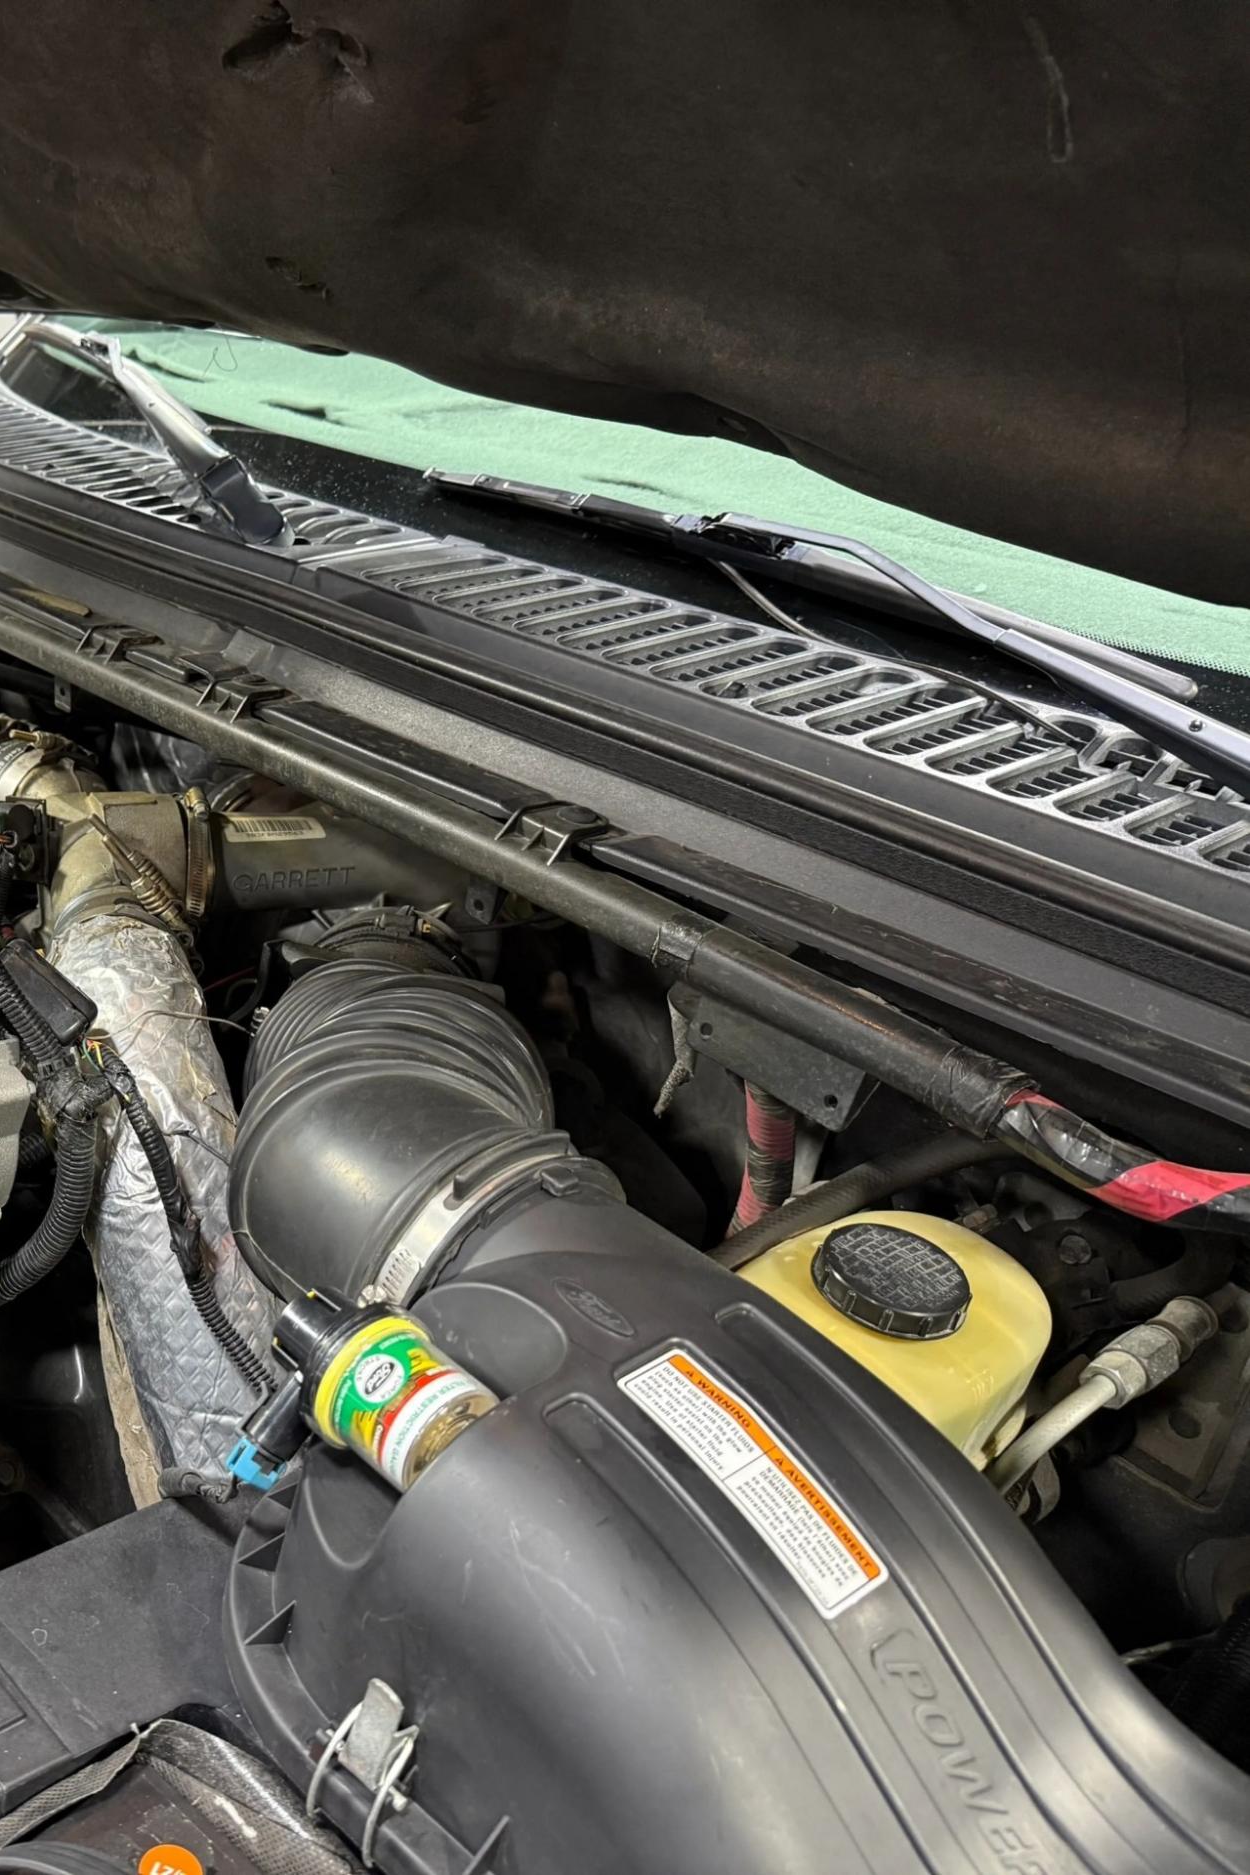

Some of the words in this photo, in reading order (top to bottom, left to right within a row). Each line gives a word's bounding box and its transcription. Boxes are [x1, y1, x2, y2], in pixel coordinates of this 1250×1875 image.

[232, 866, 356, 893] GARRETT
[365, 1362, 394, 1394] Ford
[696, 1377, 753, 1428] WARNING
[662, 1366, 675, 1376] DO
[672, 1374, 689, 1389] NOT
[686, 1387, 702, 1400] USE
[700, 1399, 732, 1427] STARTER
[729, 1425, 754, 1453] FLUIDS
[785, 1467, 873, 1569] AVERTISSEMENT
